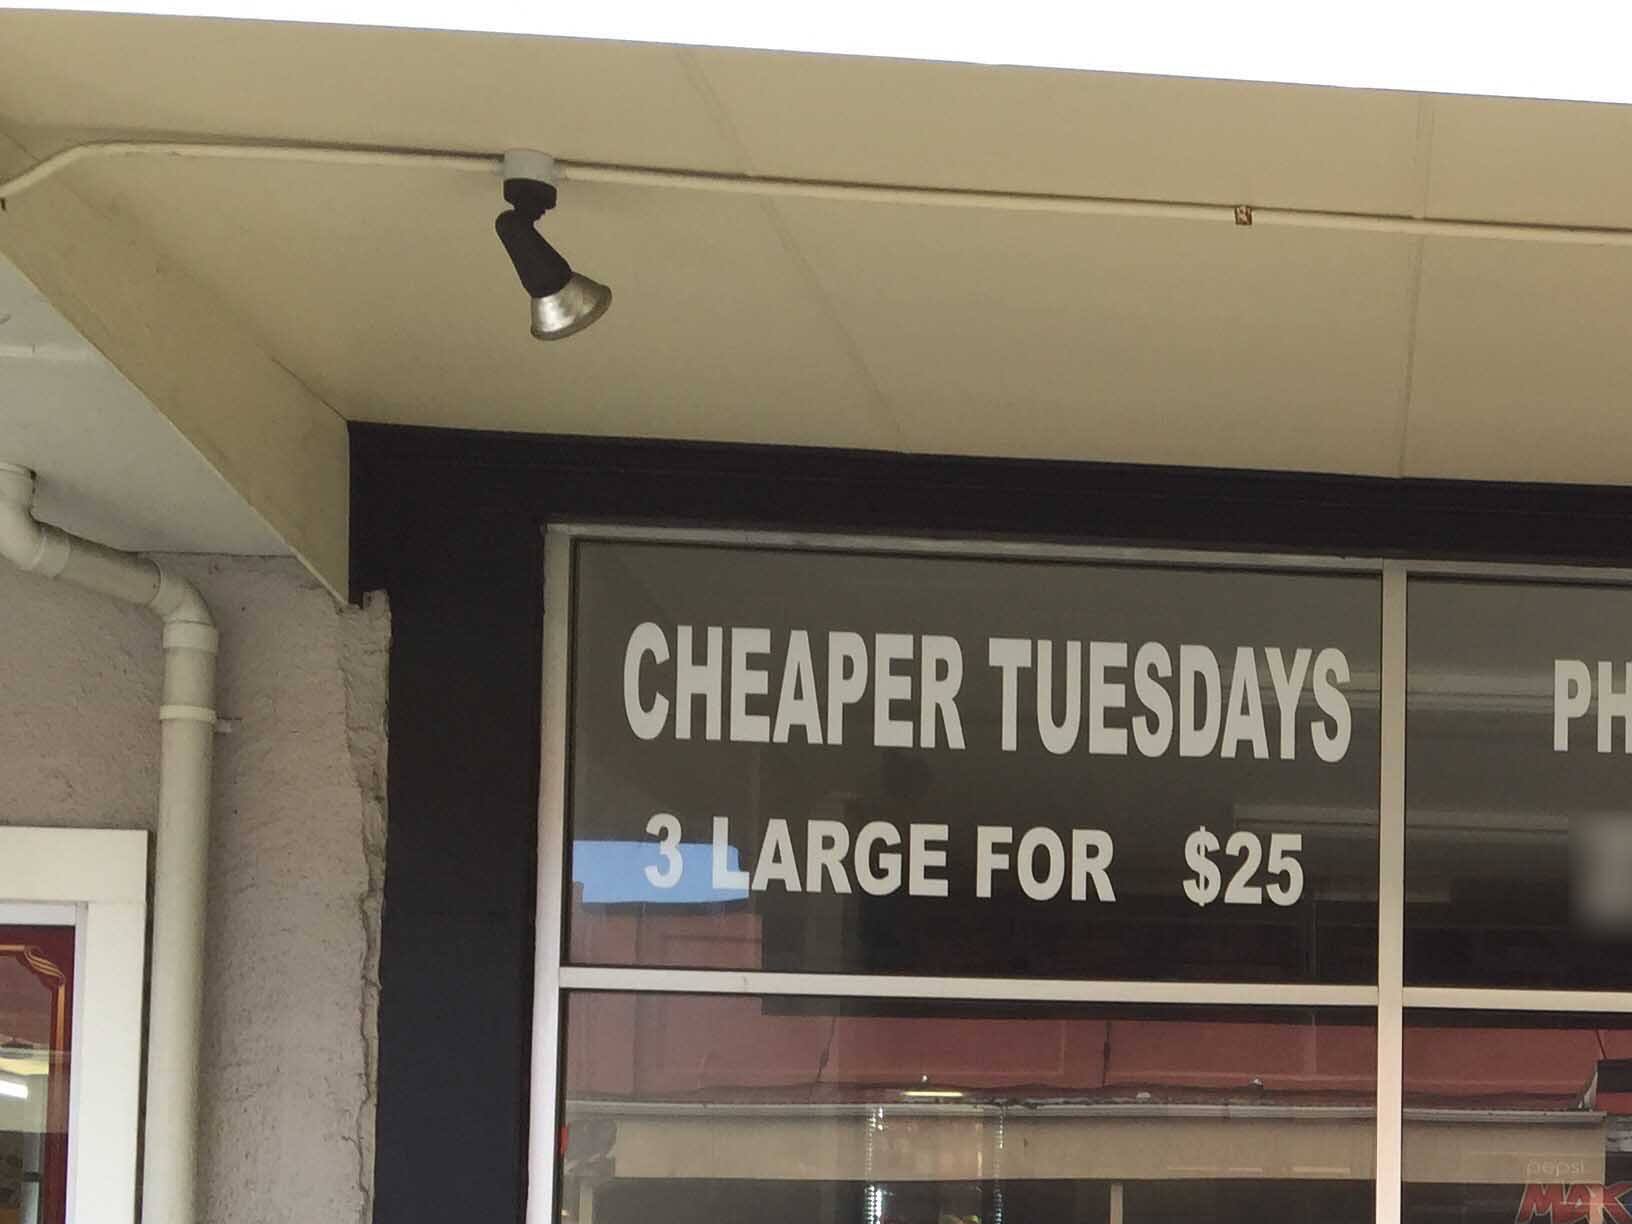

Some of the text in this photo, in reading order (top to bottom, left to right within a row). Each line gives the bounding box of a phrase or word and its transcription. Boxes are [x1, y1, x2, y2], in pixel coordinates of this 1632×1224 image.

[623, 622, 1352, 763] CHEAPER TUESDAYS
[644, 813, 1305, 906] 3 LARGE FOR $25
[1526, 1157, 1585, 1177] pepsi
